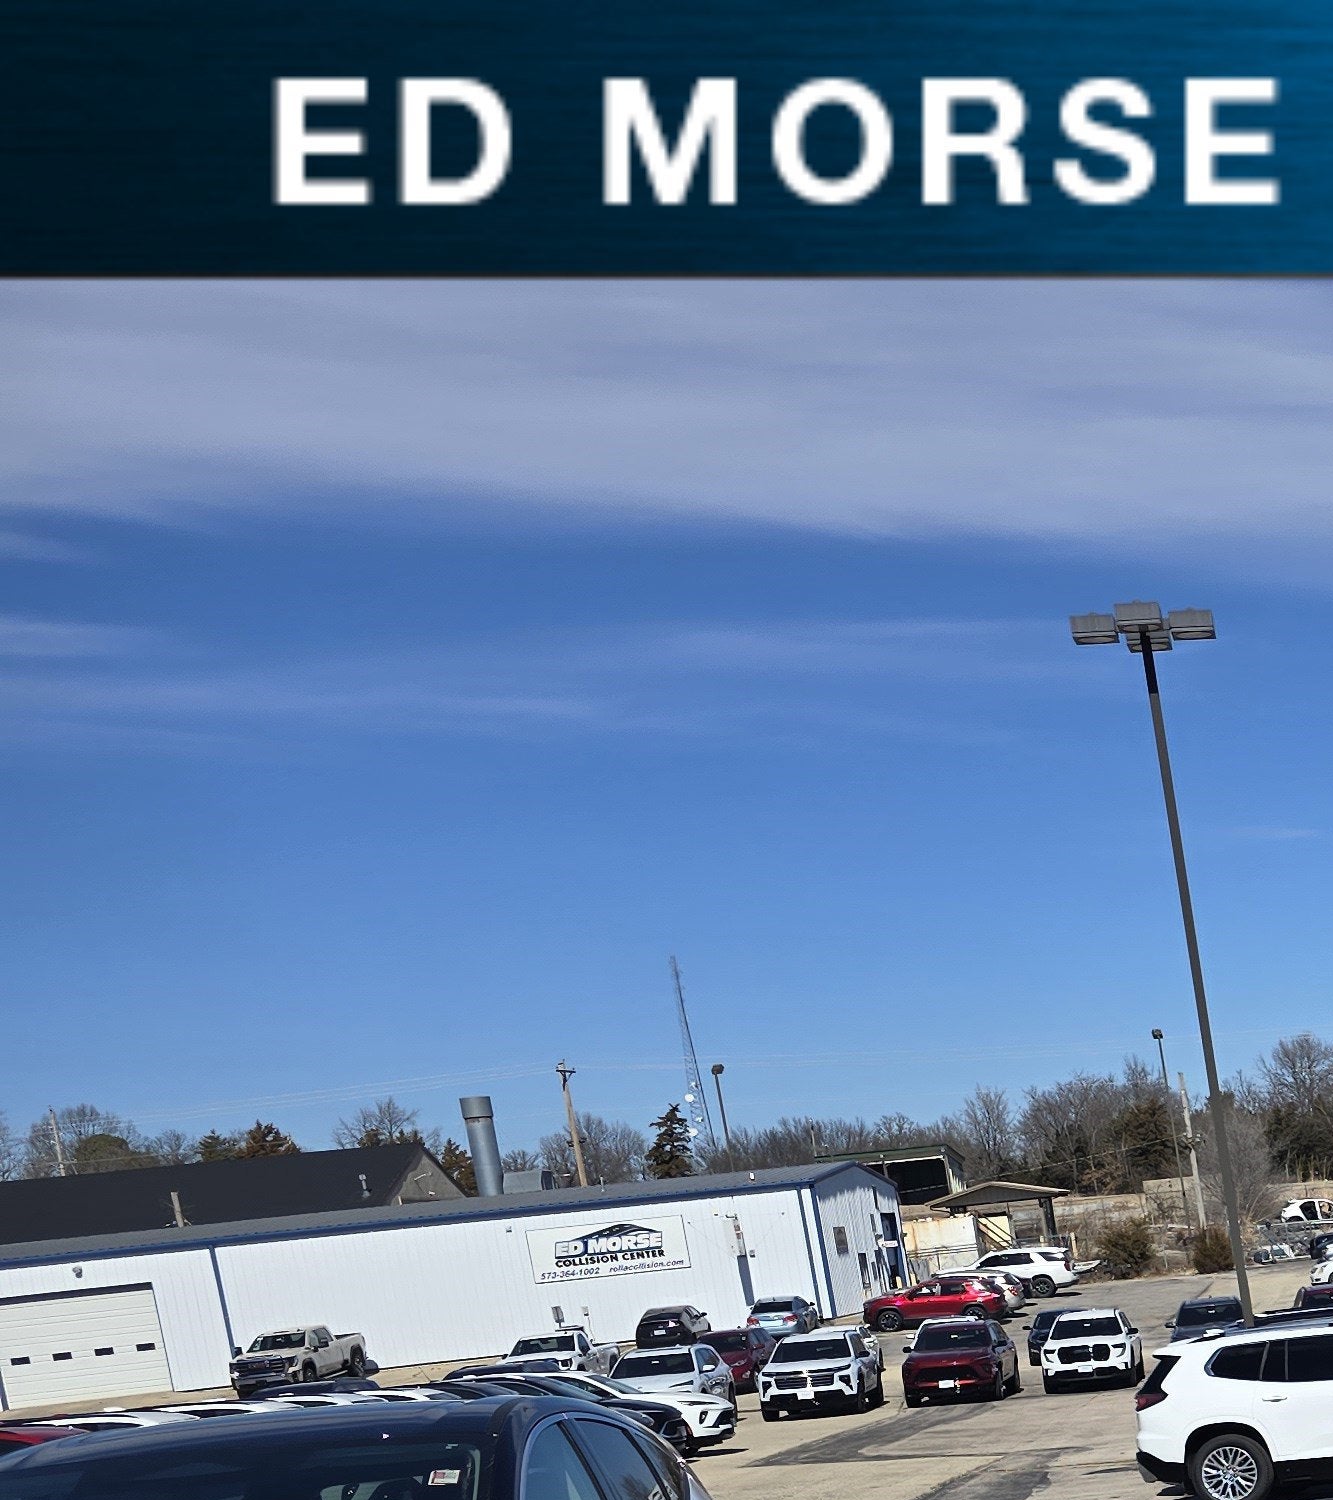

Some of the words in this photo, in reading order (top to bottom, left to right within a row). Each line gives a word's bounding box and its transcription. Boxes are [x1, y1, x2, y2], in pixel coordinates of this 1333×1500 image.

[555, 1240, 584, 1259] ED
[586, 1231, 663, 1255] MORSE
[555, 1254, 619, 1268] COLLISION
[622, 1249, 666, 1261] CENTER
[540, 1267, 601, 1281] 573-364-1002
